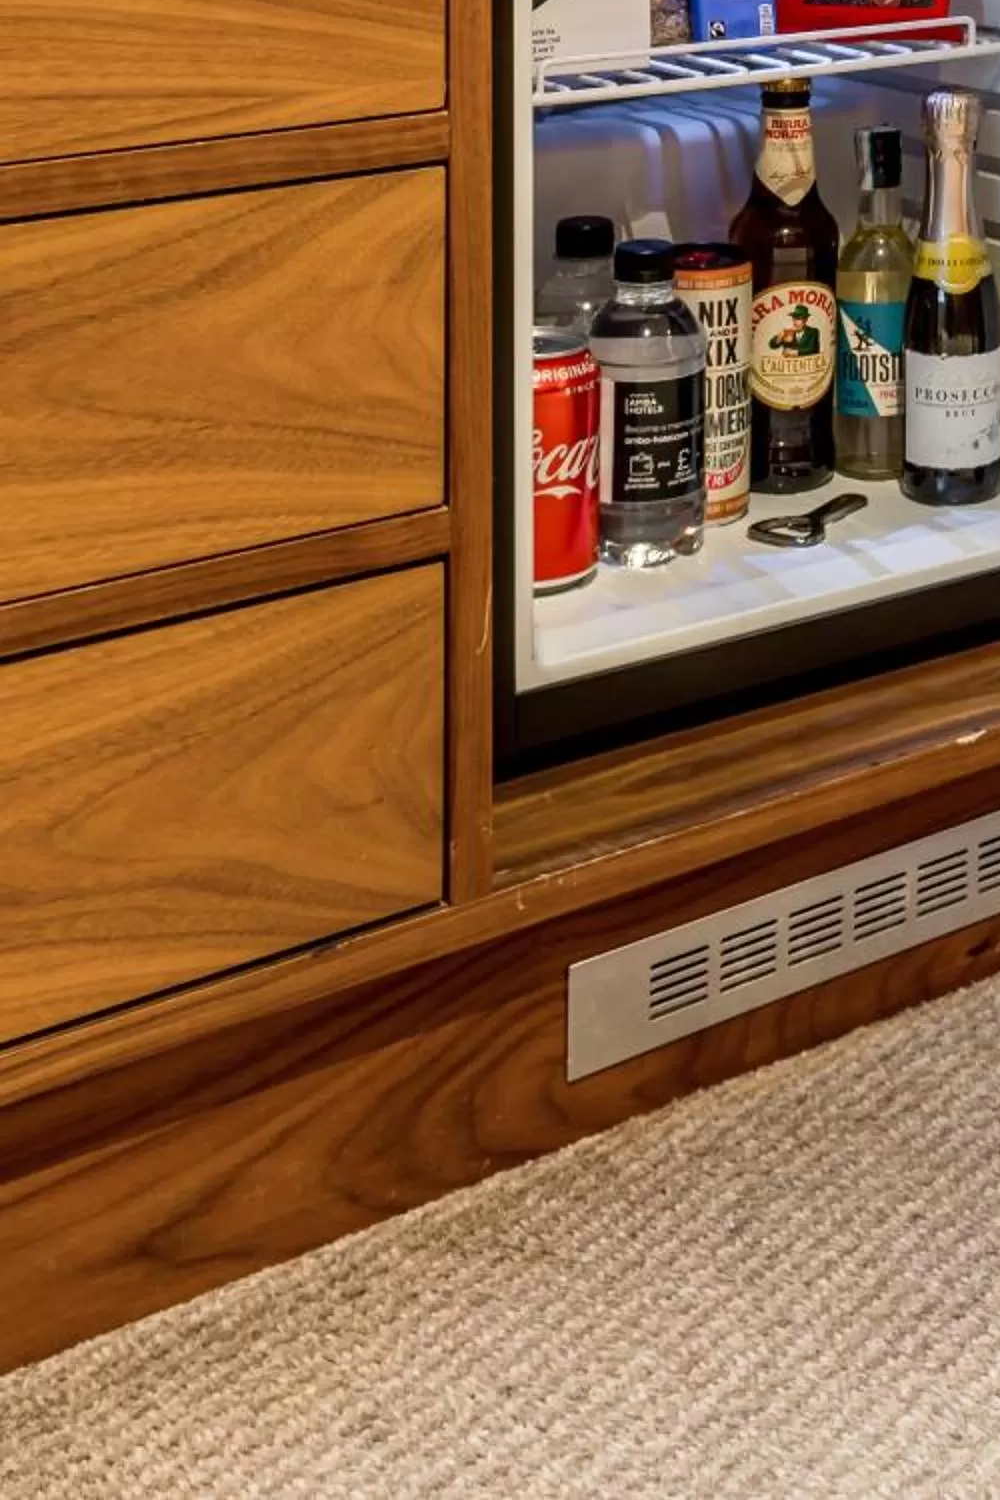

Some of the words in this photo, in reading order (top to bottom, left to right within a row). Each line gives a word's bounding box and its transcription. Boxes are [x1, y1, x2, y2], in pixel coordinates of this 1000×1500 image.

[698, 298, 739, 328] NIX
[914, 382, 1000, 403] PROSECCO
[944, 409, 977, 419] BRUT
